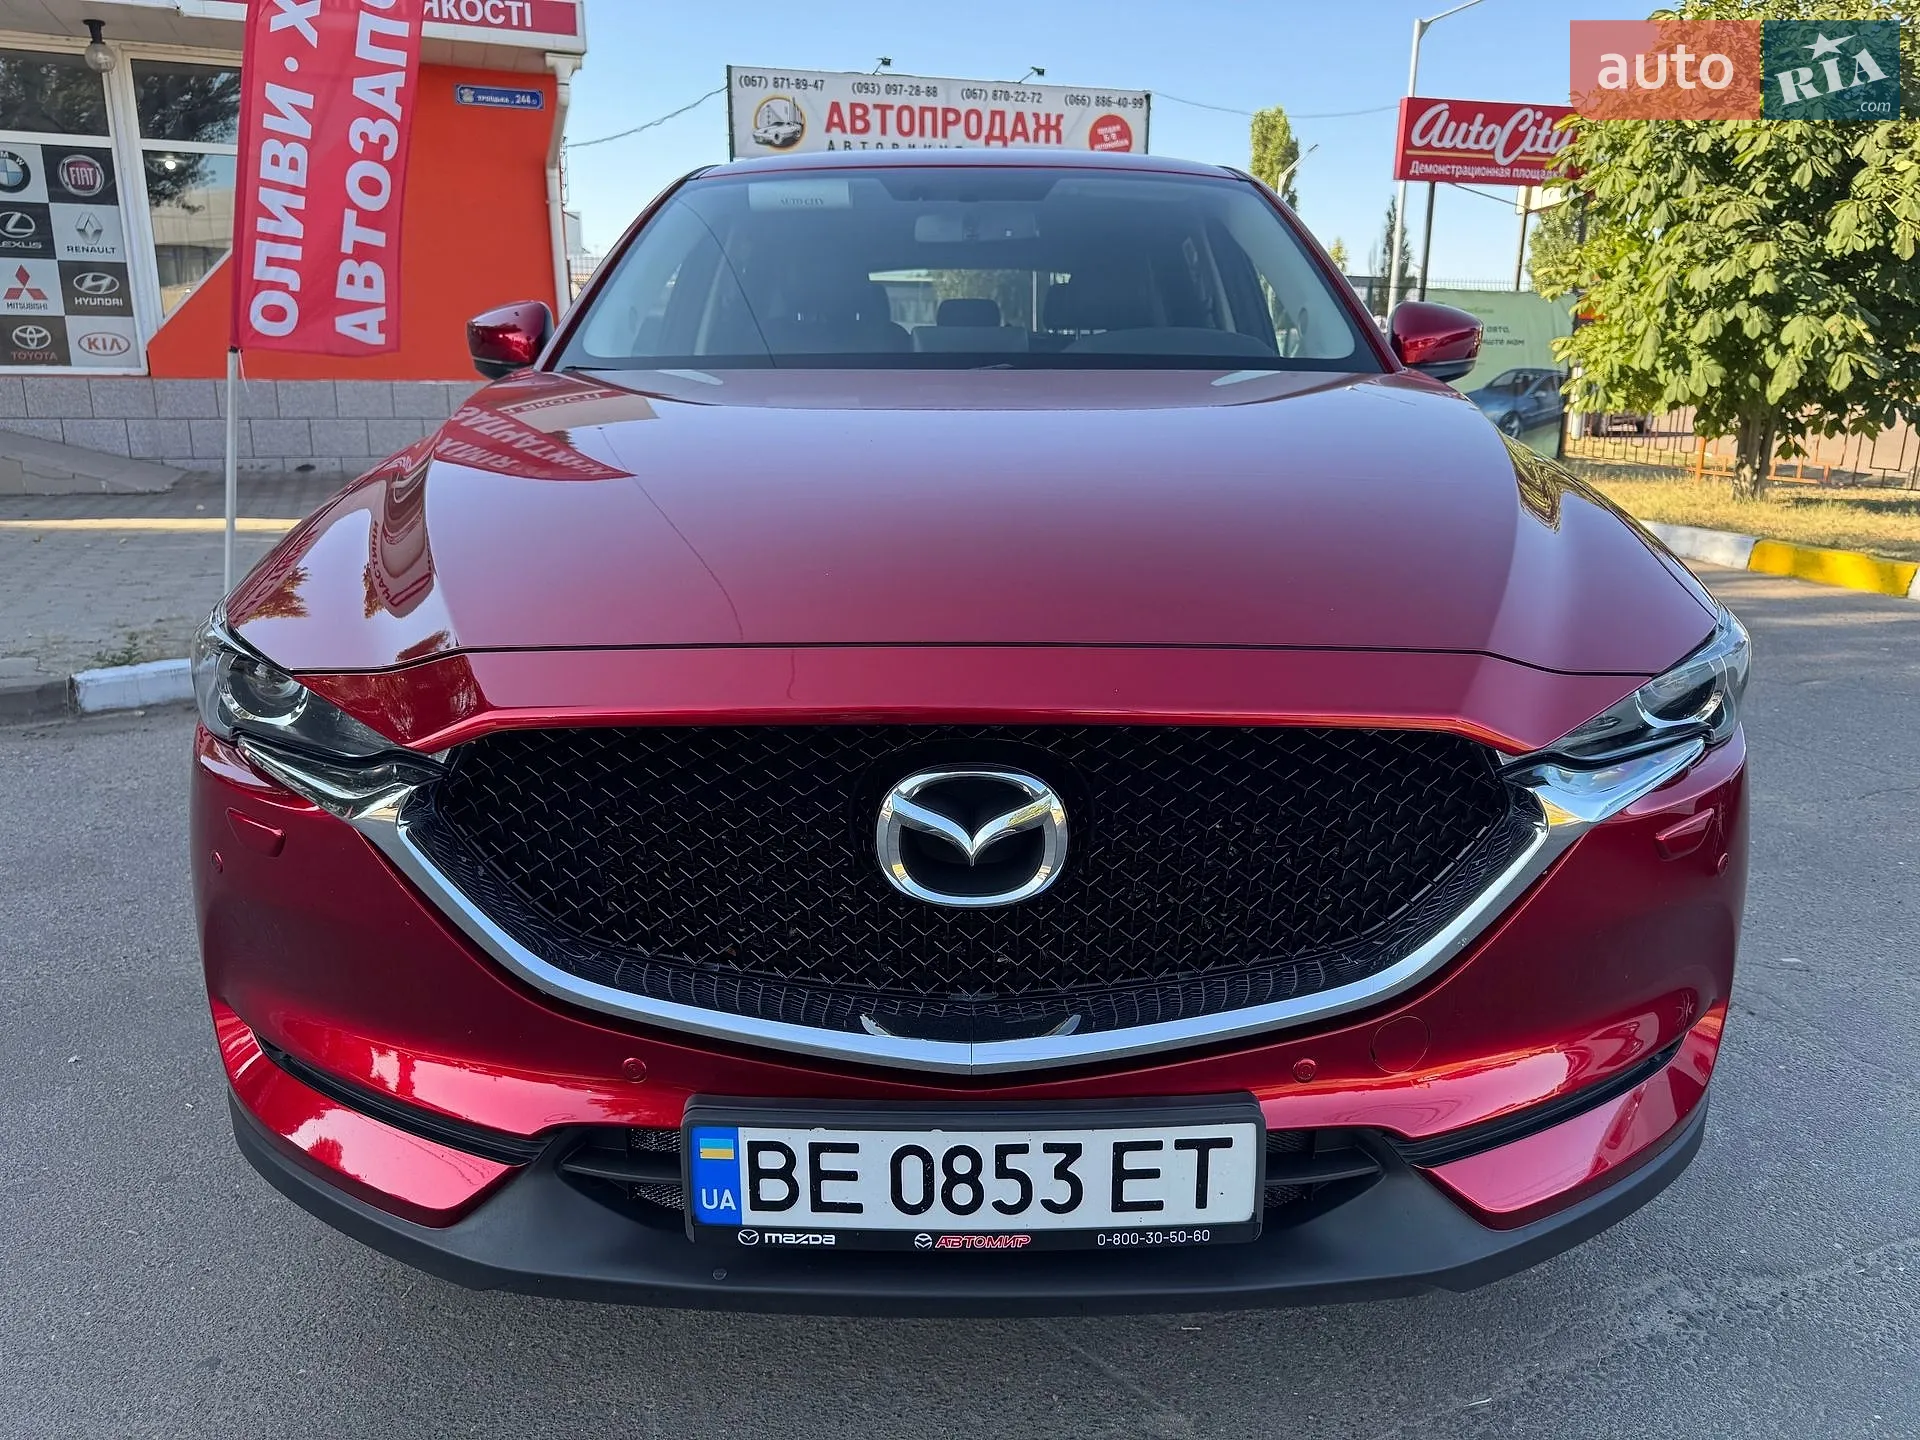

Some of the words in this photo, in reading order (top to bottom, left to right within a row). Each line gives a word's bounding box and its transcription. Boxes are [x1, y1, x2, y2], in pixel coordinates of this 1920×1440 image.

[738, 75, 769, 89] (067)
[772, 76, 825, 91] 871-89-47
[851, 82, 881, 96] (093)
[884, 83, 938, 98] 097-28-88
[824, 101, 1064, 148] АВТОПРОДАЖ
[69, 167, 95, 186] FIAT
[1409, 160, 1512, 179] Демонстрационная
[249, 82, 315, 337] ОЛИВИ
[0, 241, 42, 249] EXUS
[66, 245, 117, 255] RENAULT
[6, 302, 48, 311] MITSUBISHI
[74, 297, 123, 307] HYUNDAI
[87, 337, 122, 352] KIA
[10, 351, 58, 361] TOYOTA
[747, 1140, 864, 1214] BE
[890, 1142, 1084, 1216] 0853
[1111, 1137, 1233, 1213] ET
[701, 1188, 736, 1210] UA
[764, 1232, 836, 1246] mazda
[935, 1234, 1031, 1249] АВТОМИР
[1097, 1229, 1210, 1246] 0-800-30-50-60
